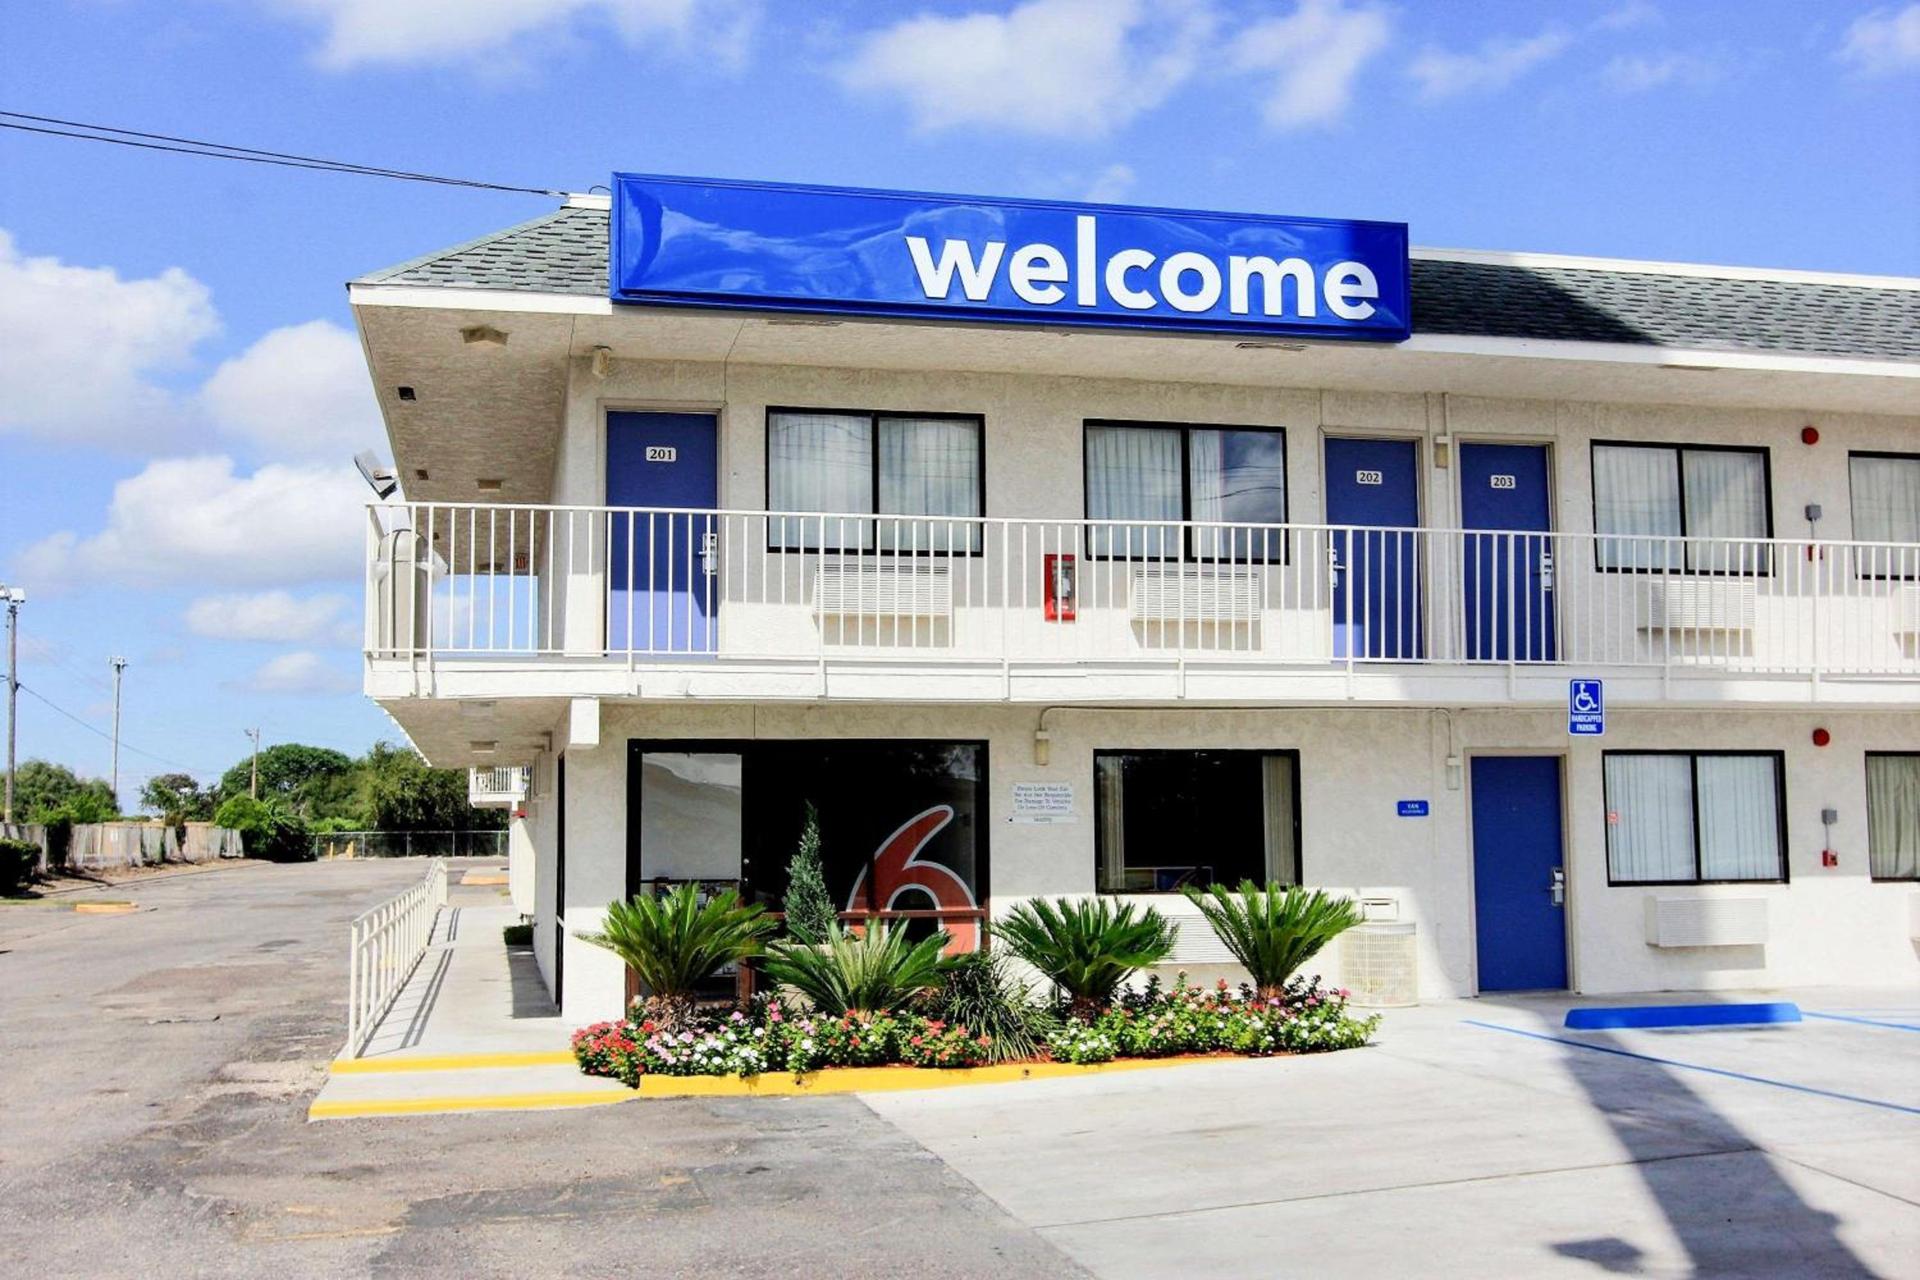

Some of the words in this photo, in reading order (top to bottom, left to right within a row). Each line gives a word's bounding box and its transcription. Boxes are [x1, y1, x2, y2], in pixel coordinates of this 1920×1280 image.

[905, 215, 1380, 321] welcome
[649, 448, 673, 460] 201
[1359, 472, 1380, 483] 202
[1493, 477, 1513, 487] 203
[843, 803, 981, 960] 6
